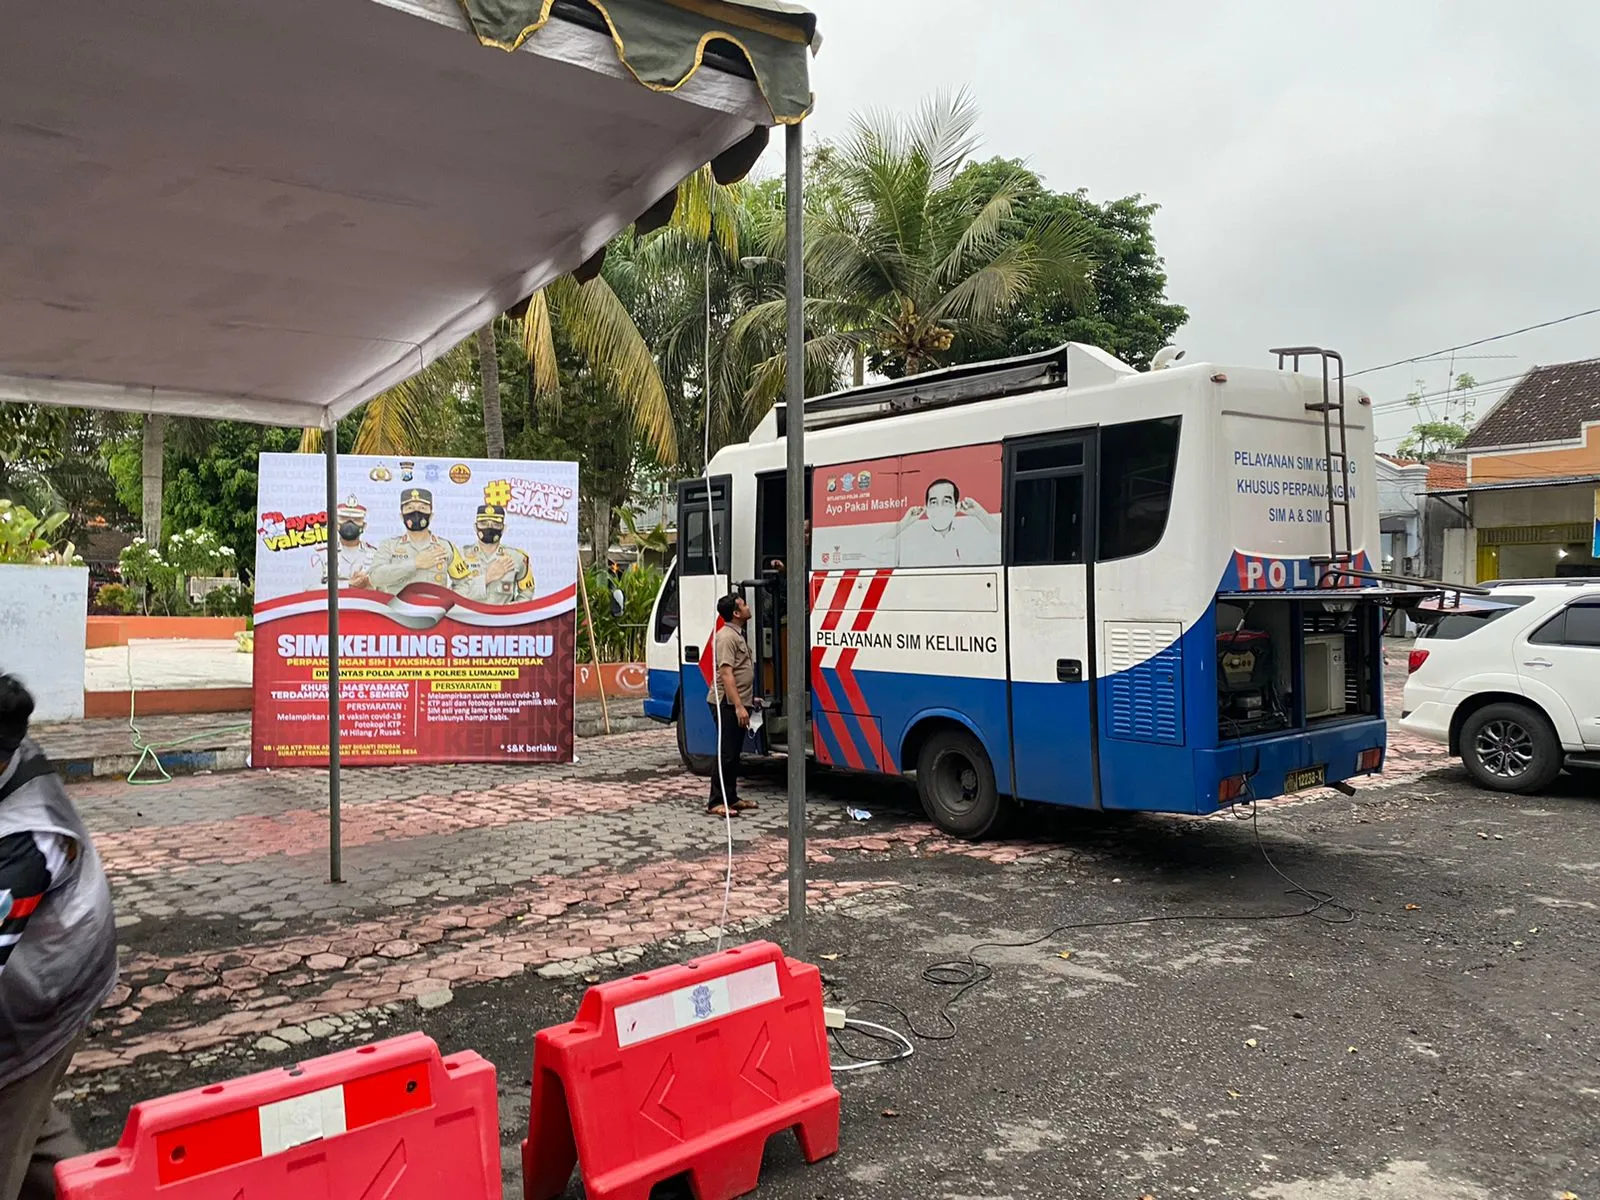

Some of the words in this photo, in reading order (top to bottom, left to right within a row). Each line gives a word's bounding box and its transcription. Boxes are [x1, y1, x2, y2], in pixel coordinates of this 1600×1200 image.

[1234, 451, 1294, 468] PELAYANAN
[1297, 456, 1313, 470] SIM
[510, 477, 573, 499] LUMAJANG
[1237, 479, 1280, 495] KHUSUS
[511, 487, 565, 510] SIAP
[825, 503, 843, 516] Ayo
[844, 500, 869, 512] Pakai
[871, 496, 908, 510] Masker!
[507, 501, 569, 524] DIVAKSIN
[1269, 508, 1286, 521] SIM
[1288, 509, 1295, 521] A
[1297, 509, 1304, 522] &
[1306, 509, 1323, 523] SIM
[277, 633, 329, 657] SIM
[338, 634, 446, 657] KELILING
[450, 634, 554, 657] SEMERU
[816, 631, 892, 649] PELAYANAN
[896, 633, 921, 650] SIM
[926, 635, 997, 653] KELILING
[367, 658, 386, 667] SIM
[393, 658, 445, 667] VAKSINASI
[453, 658, 471, 666] SIM
[472, 657, 544, 666] HILANG/RUSAK
[469, 669, 516, 677] LUMAJANG
[342, 683, 410, 691] MASYARAKAT
[435, 682, 492, 690] PERSYARATAN
[369, 691, 409, 699] SEMERU
[346, 703, 402, 711] PERSYARATAN
[277, 713, 326, 722] Melampirkan
[347, 713, 370, 721] vaksin
[350, 729, 372, 738] Hilang
